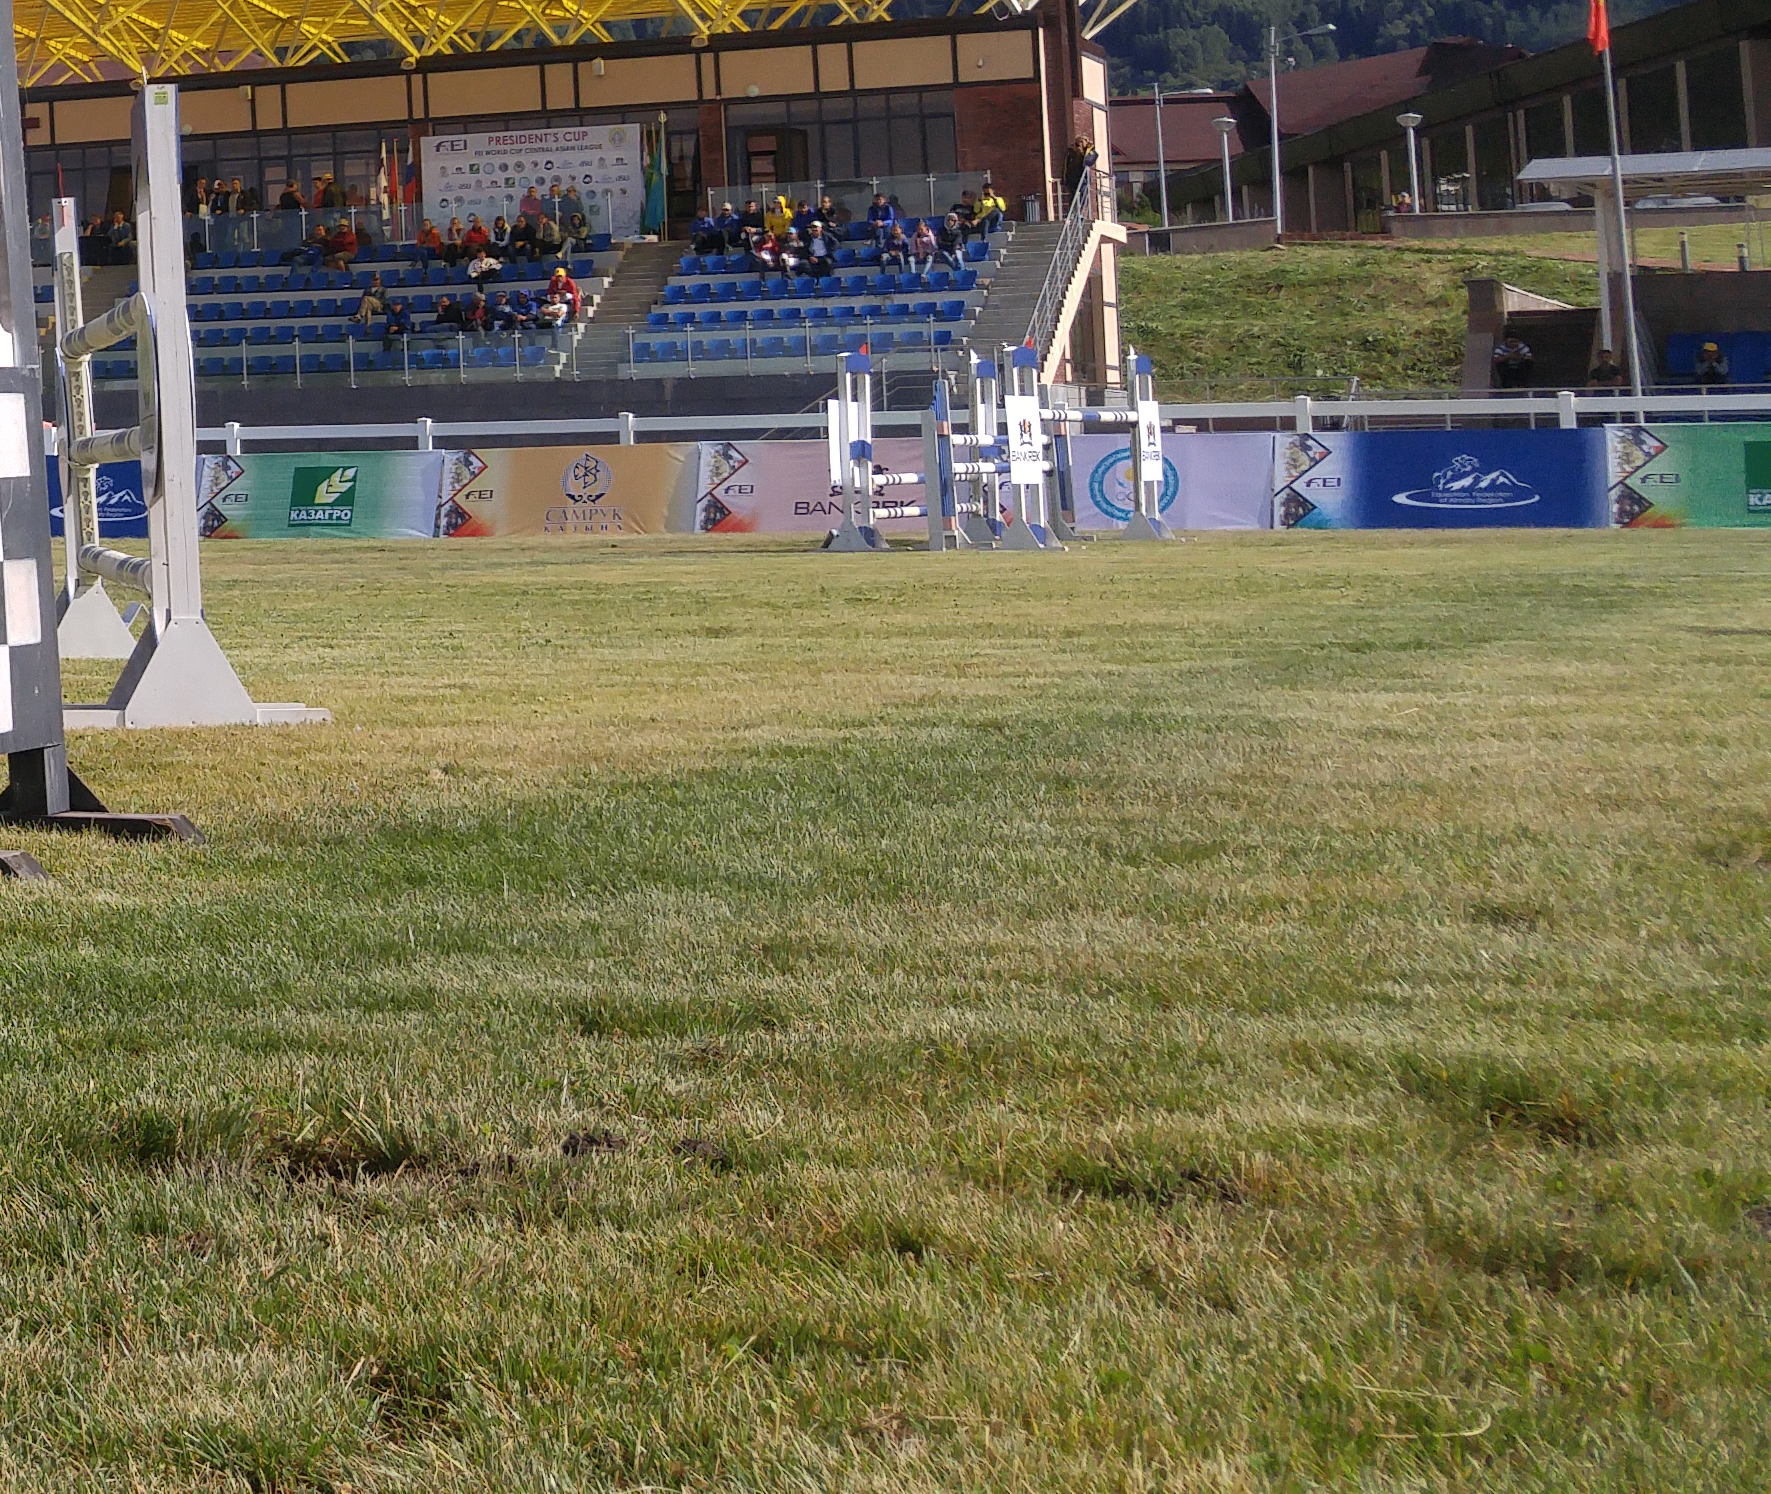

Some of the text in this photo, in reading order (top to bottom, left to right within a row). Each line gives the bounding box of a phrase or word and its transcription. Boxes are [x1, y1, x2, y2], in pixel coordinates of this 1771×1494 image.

[487, 130, 589, 146] PRESIDENT'S CUP
[434, 139, 468, 153] FEI
[525, 146, 553, 154] CENTRAL
[555, 145, 576, 153] ASIAN
[1304, 477, 1341, 488] FEI
[1640, 473, 1680, 484] FEI
[464, 489, 494, 500] FEI
[723, 484, 754, 495] FEI
[221, 493, 249, 503] FEI
[289, 509, 352, 521] КАЗАГРО
[545, 507, 623, 523] САМРУК
